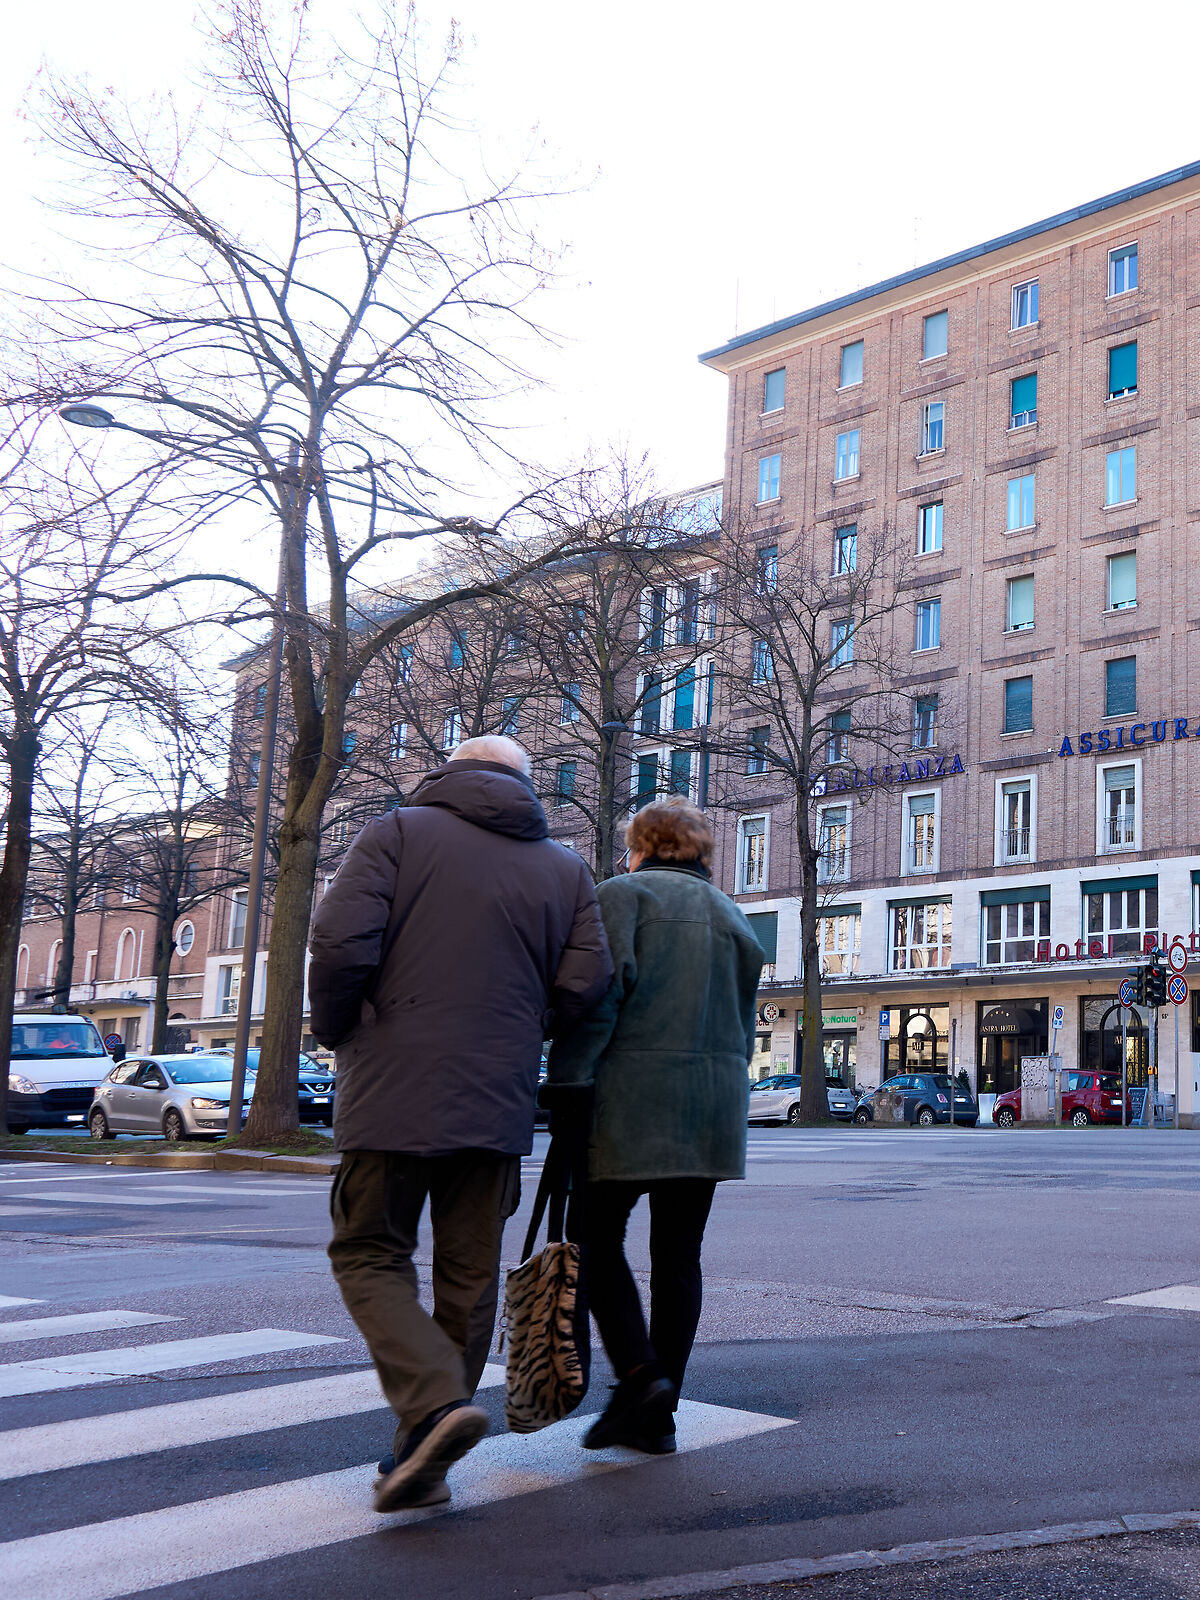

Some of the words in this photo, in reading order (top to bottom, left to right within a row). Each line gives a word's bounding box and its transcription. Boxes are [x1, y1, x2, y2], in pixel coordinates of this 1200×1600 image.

[834, 754, 965, 791] ALLEANZA
[1037, 936, 1114, 962] Hotel
[882, 1013, 888, 1022] P
